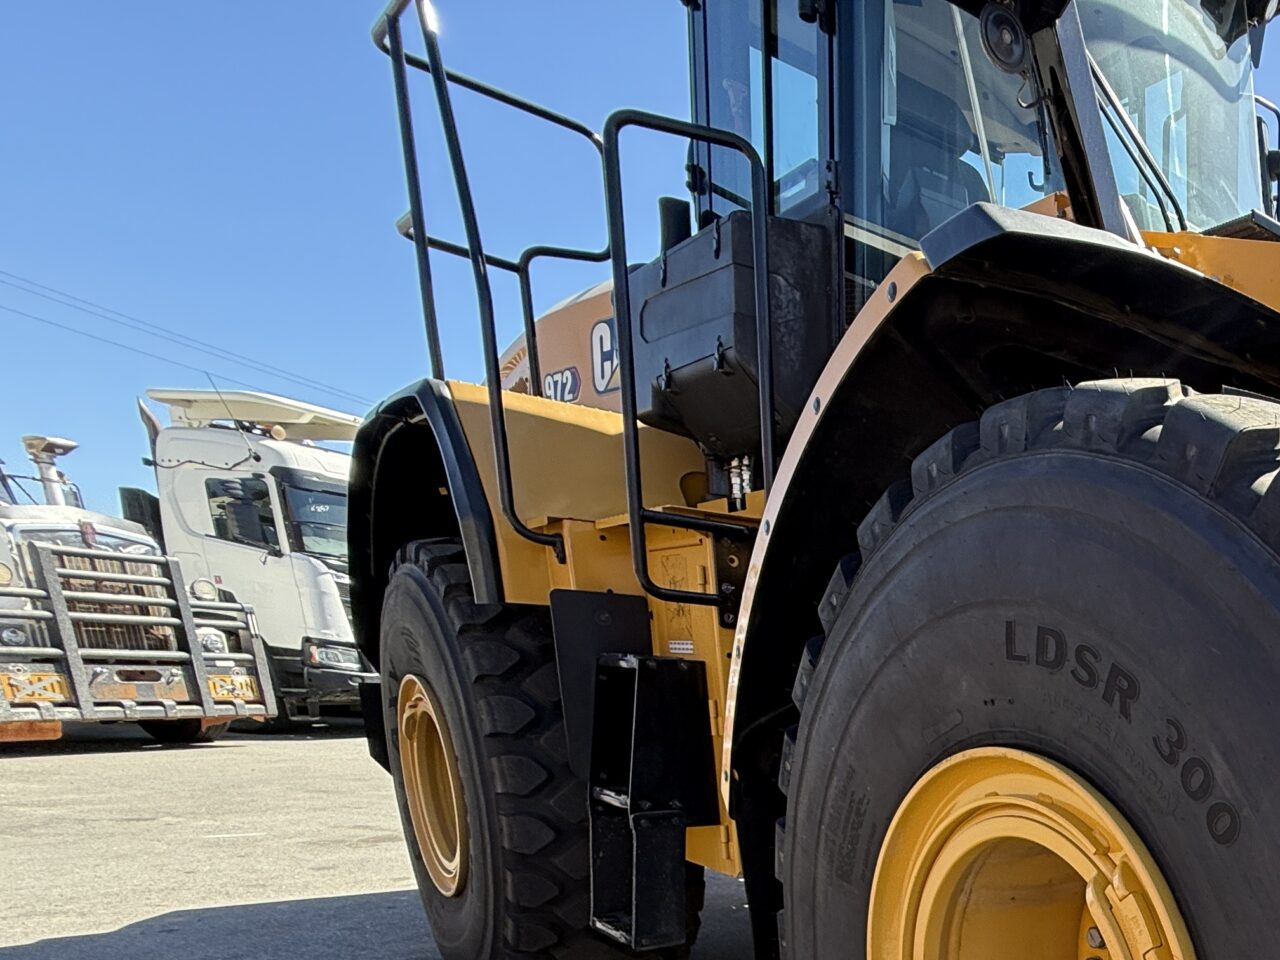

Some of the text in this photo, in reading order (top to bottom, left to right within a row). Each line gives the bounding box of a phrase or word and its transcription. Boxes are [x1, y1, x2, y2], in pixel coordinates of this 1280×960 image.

[545, 370, 574, 401] 972
[1004, 619, 1241, 847] LDSR 300
